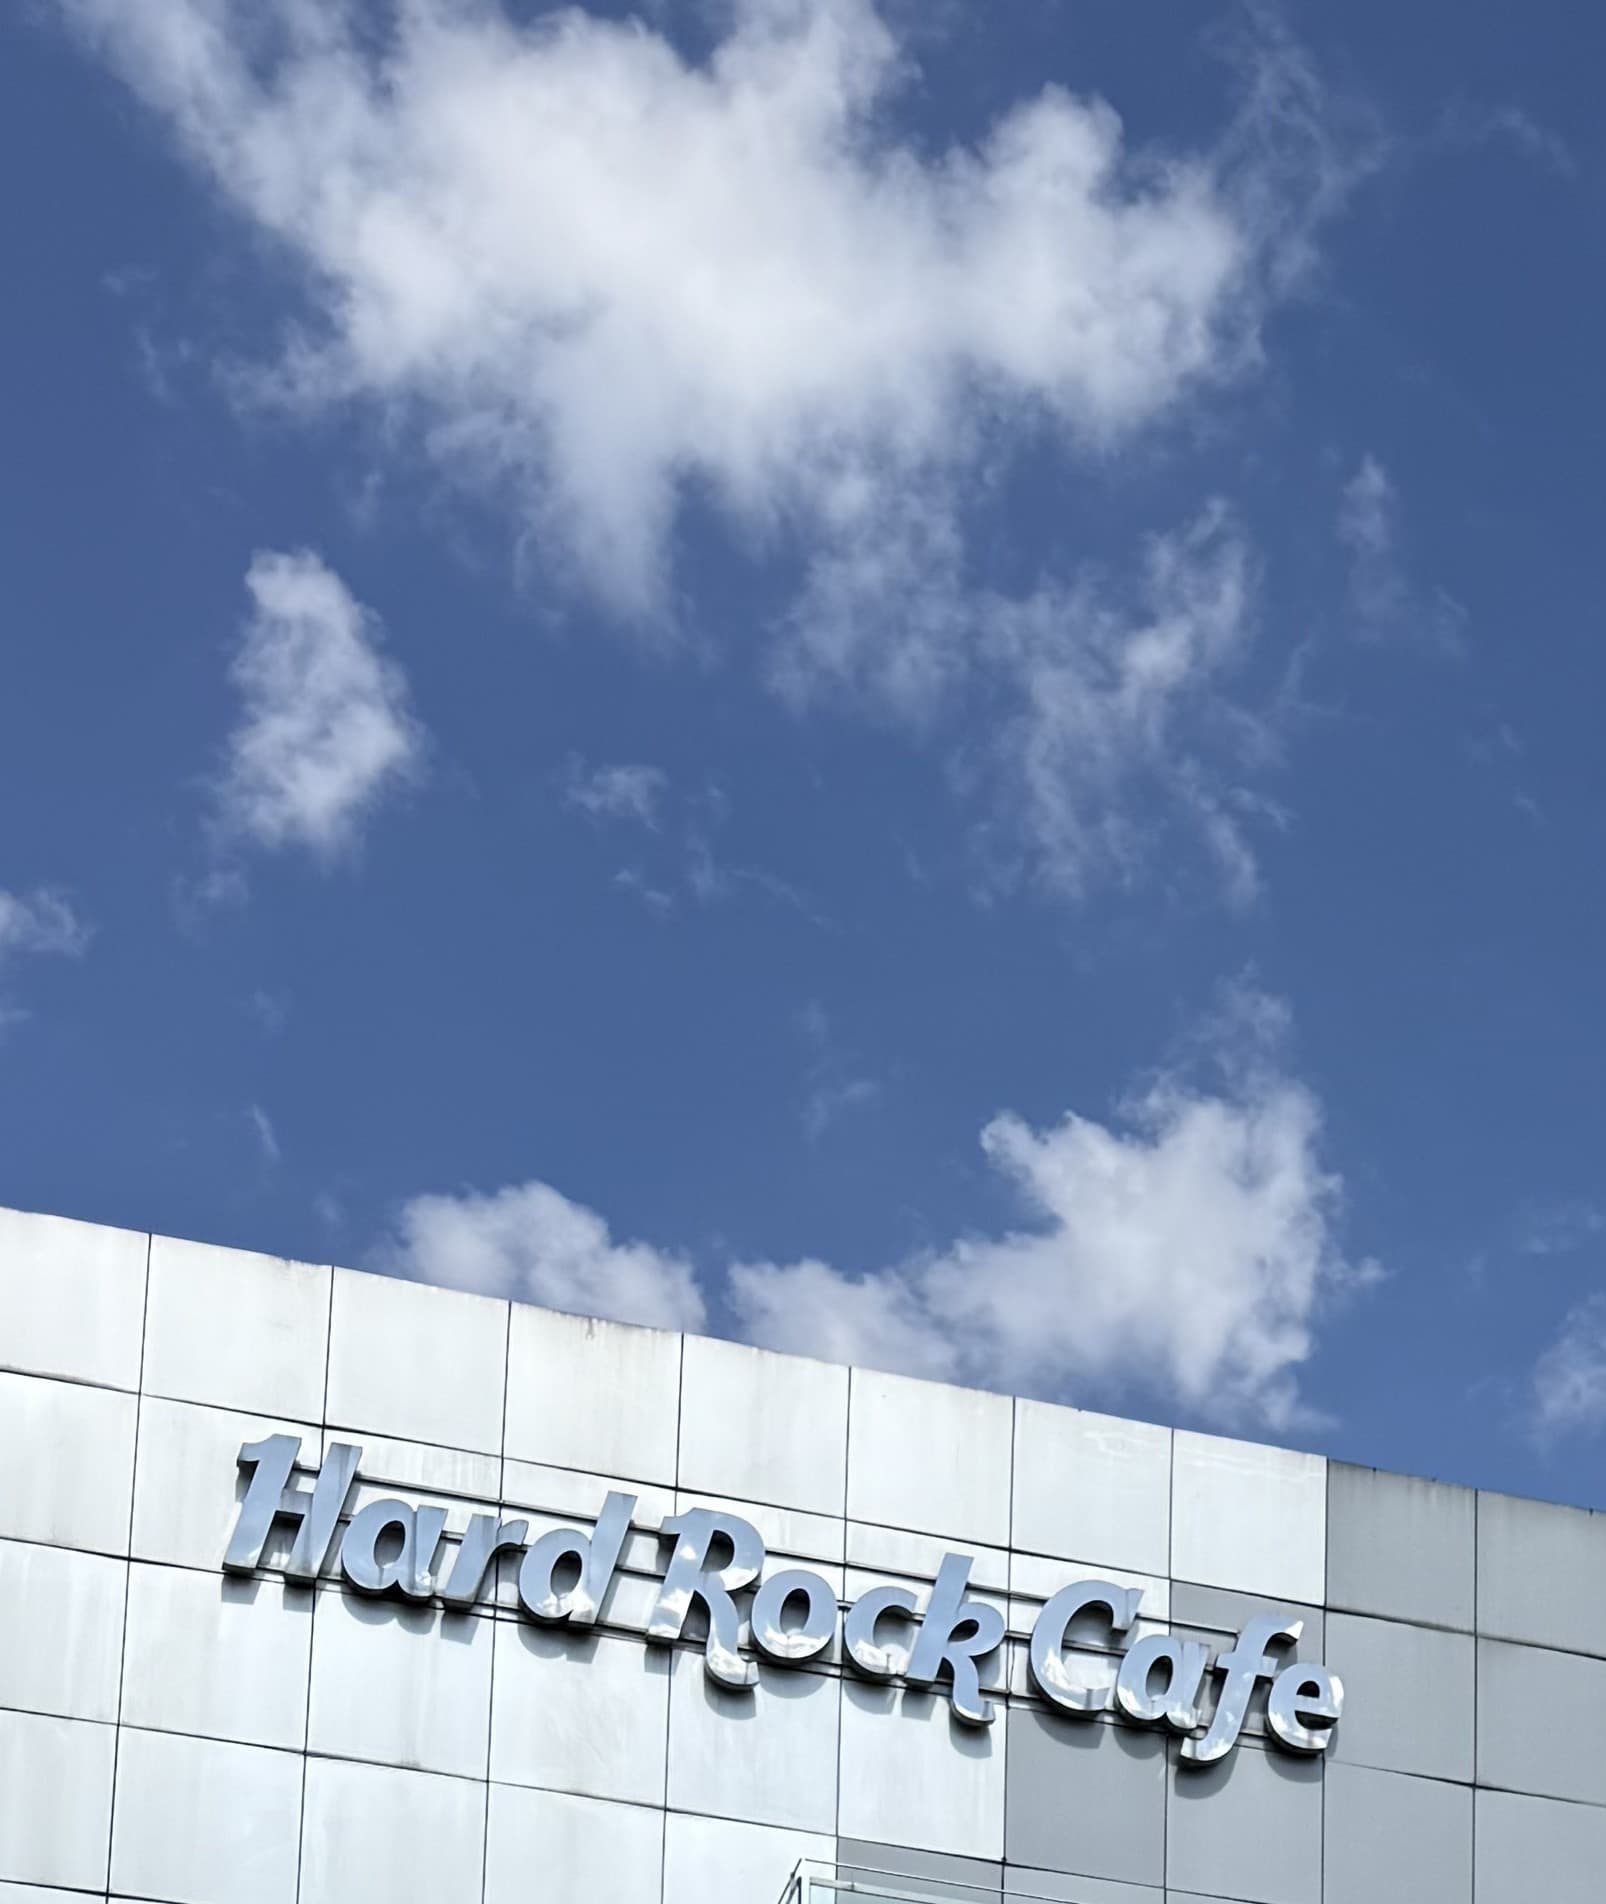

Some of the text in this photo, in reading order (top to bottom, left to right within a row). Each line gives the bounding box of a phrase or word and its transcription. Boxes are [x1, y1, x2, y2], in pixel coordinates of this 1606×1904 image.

[222, 1435, 1343, 1767] Hard Rock Cafe
